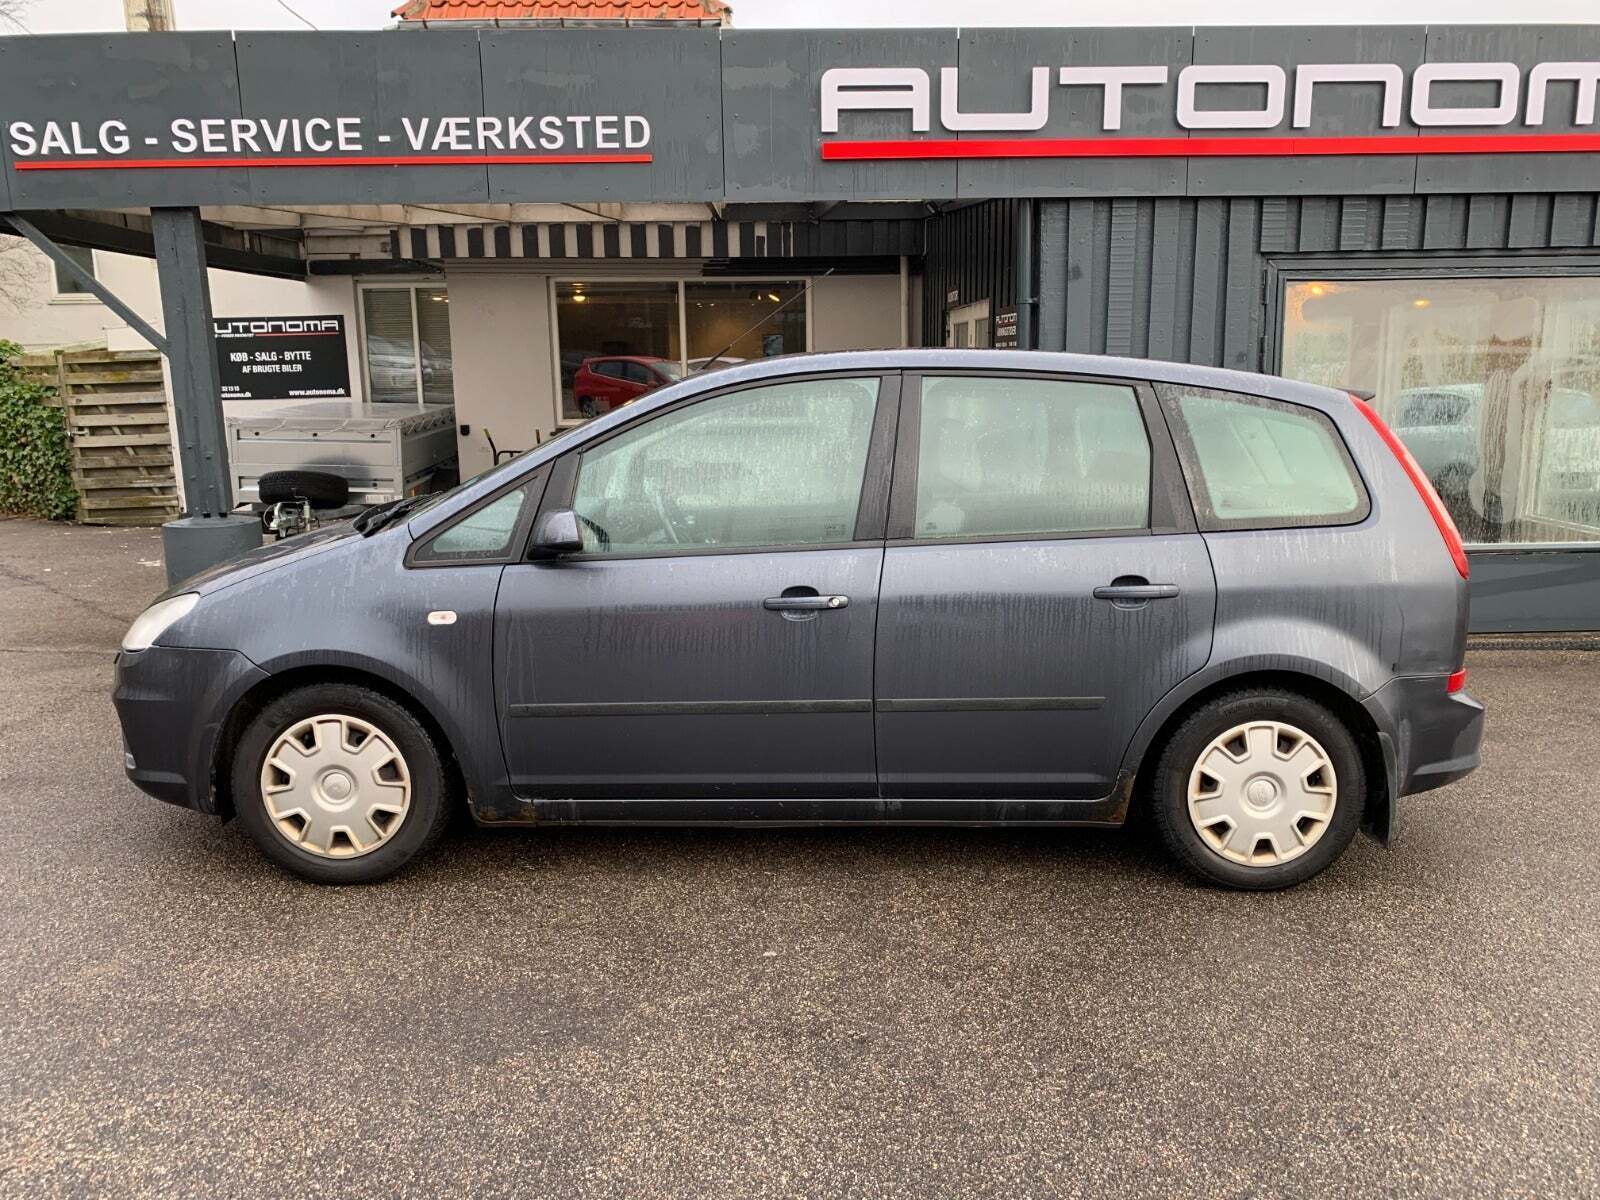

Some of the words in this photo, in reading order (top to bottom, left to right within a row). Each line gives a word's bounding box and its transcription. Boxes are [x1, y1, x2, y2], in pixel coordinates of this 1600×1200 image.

[9, 119, 130, 156] SALG
[171, 116, 363, 152] SERVICE
[402, 115, 651, 150] VÆRKSTED
[230, 352, 248, 362] KØB
[255, 352, 277, 361] SALG
[284, 351, 312, 361] BYTTE
[242, 365, 252, 373] AF
[253, 364, 280, 373] BRUGTE
[281, 364, 303, 373] BILER
[288, 388, 345, 396] www.autonoma.dk
